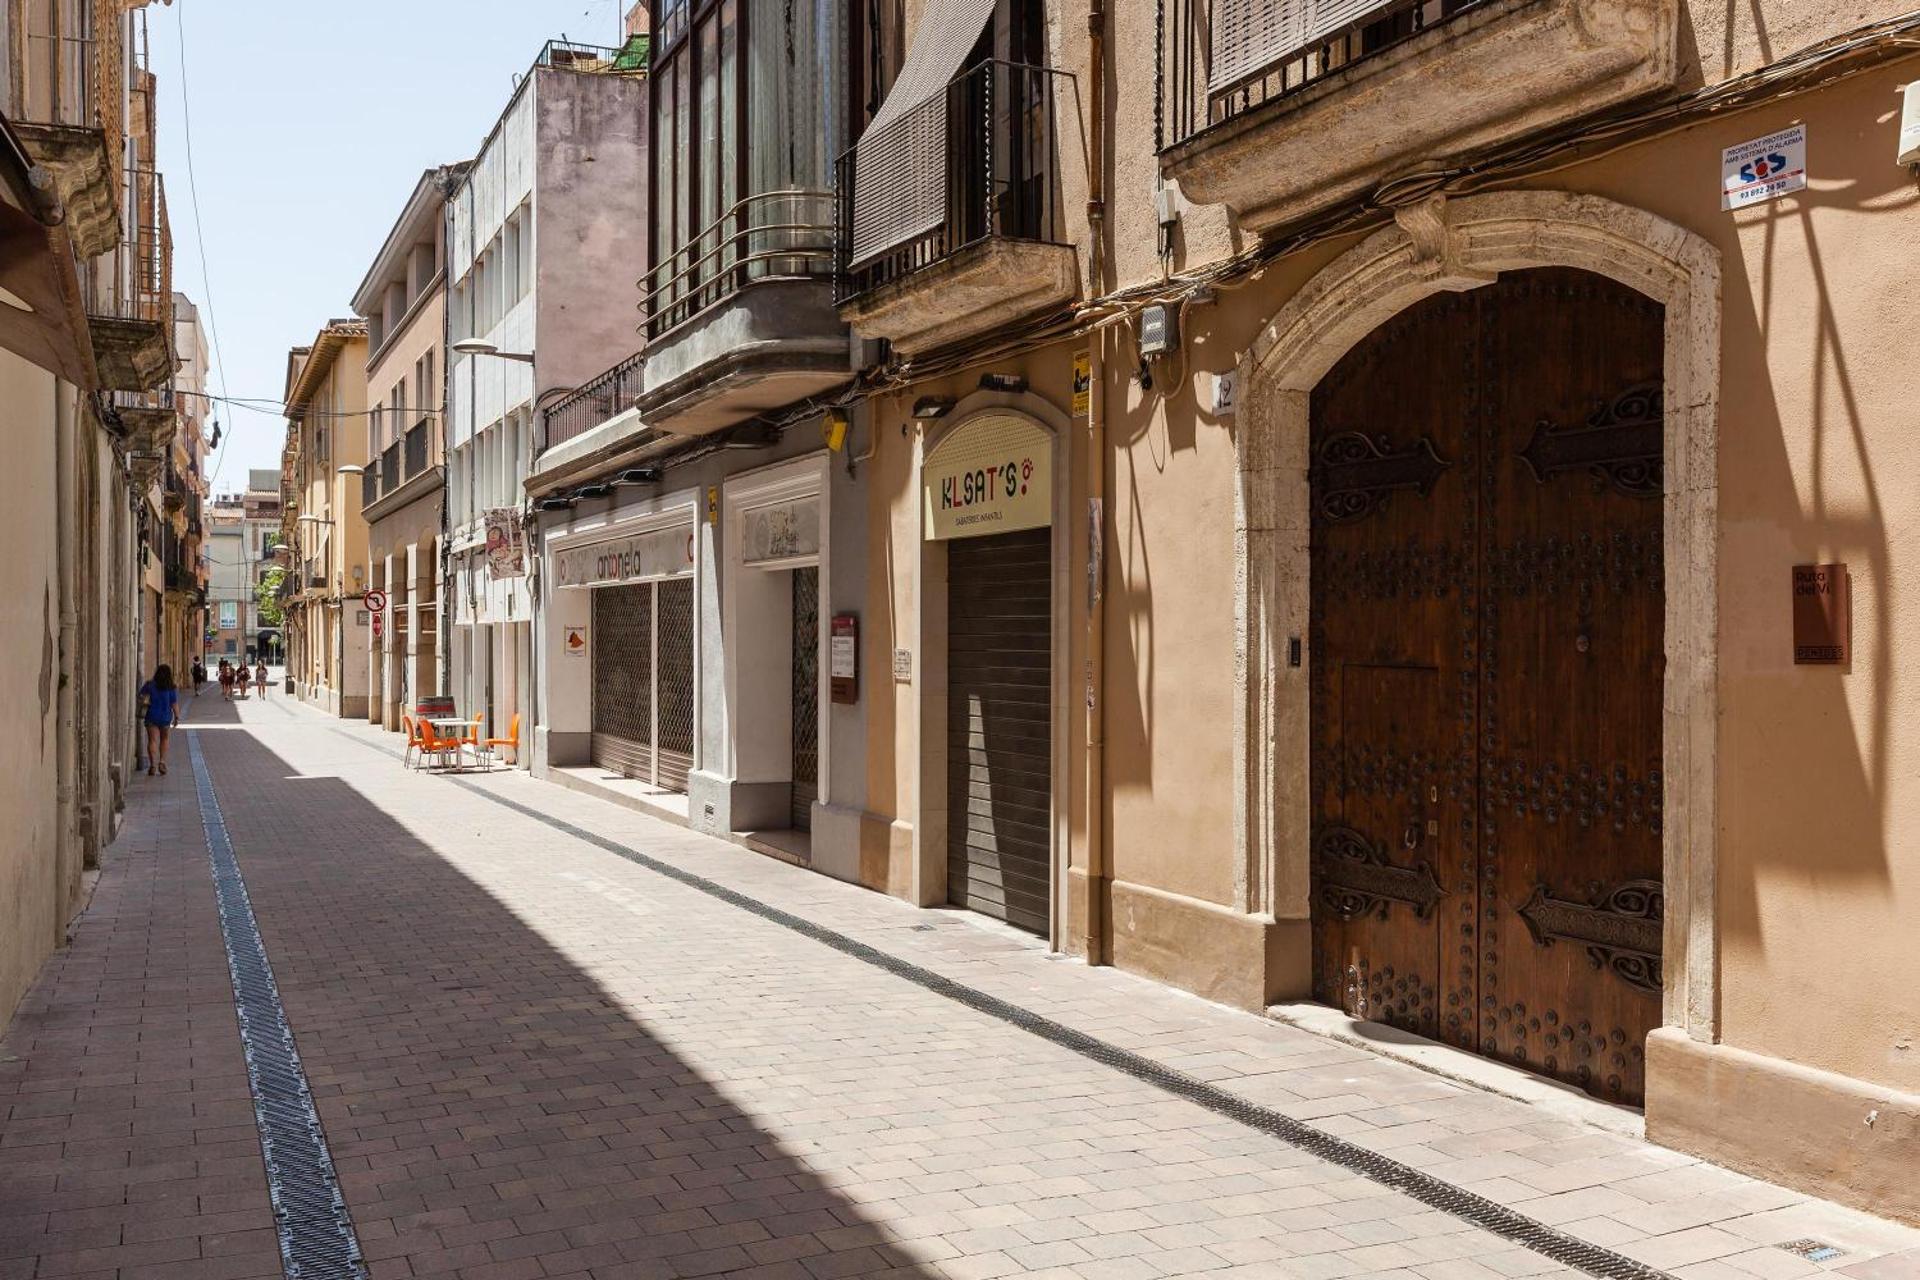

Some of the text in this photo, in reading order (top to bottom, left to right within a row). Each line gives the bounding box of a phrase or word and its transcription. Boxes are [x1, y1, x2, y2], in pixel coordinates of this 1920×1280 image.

[1725, 155, 1739, 164] AMB
[1740, 148, 1767, 161] SISTEMA
[1727, 129, 1801, 156] PROPIETAT PROTEGIDA
[1740, 152, 1786, 183] SOS
[1217, 379, 1232, 409] 12
[942, 462, 1017, 510] KLSAT'S
[597, 548, 641, 578] antonela
[1797, 572, 1825, 581] Ruta
[1796, 583, 1830, 595] del Vi
